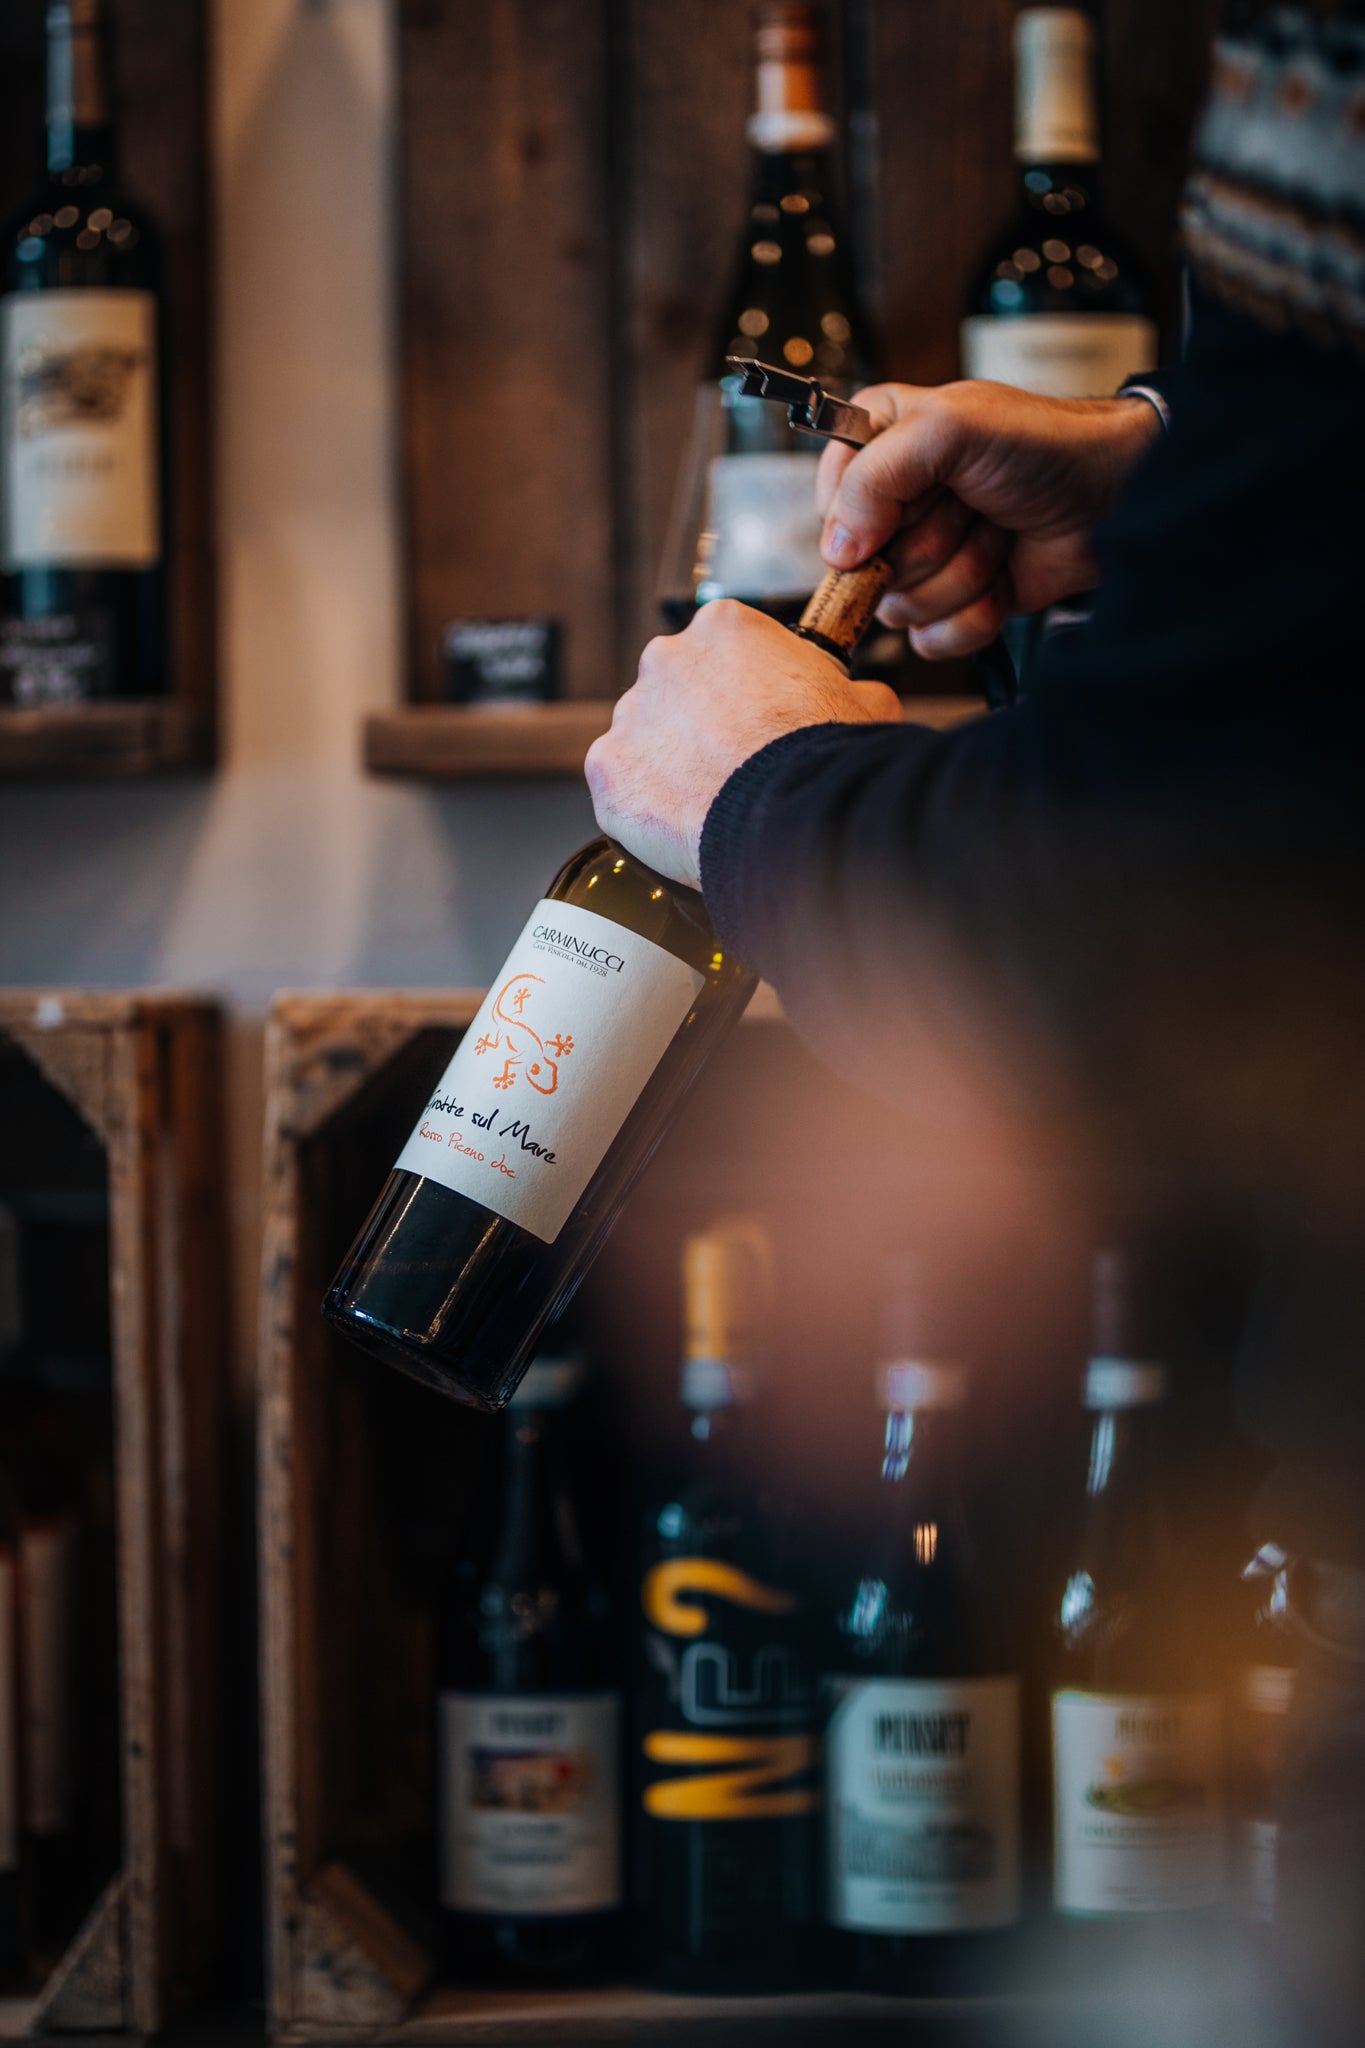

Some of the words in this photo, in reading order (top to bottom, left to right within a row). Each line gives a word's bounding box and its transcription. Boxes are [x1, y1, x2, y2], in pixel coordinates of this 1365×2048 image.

[532, 925, 625, 973] CARMINUCCI
[589, 964, 608, 977] 1928
[418, 1121, 443, 1143] Rosso
[447, 1131, 485, 1161] Piceno
[490, 1153, 516, 1179] doc
[471, 1109, 499, 1131] sul
[499, 1120, 557, 1164] Mare
